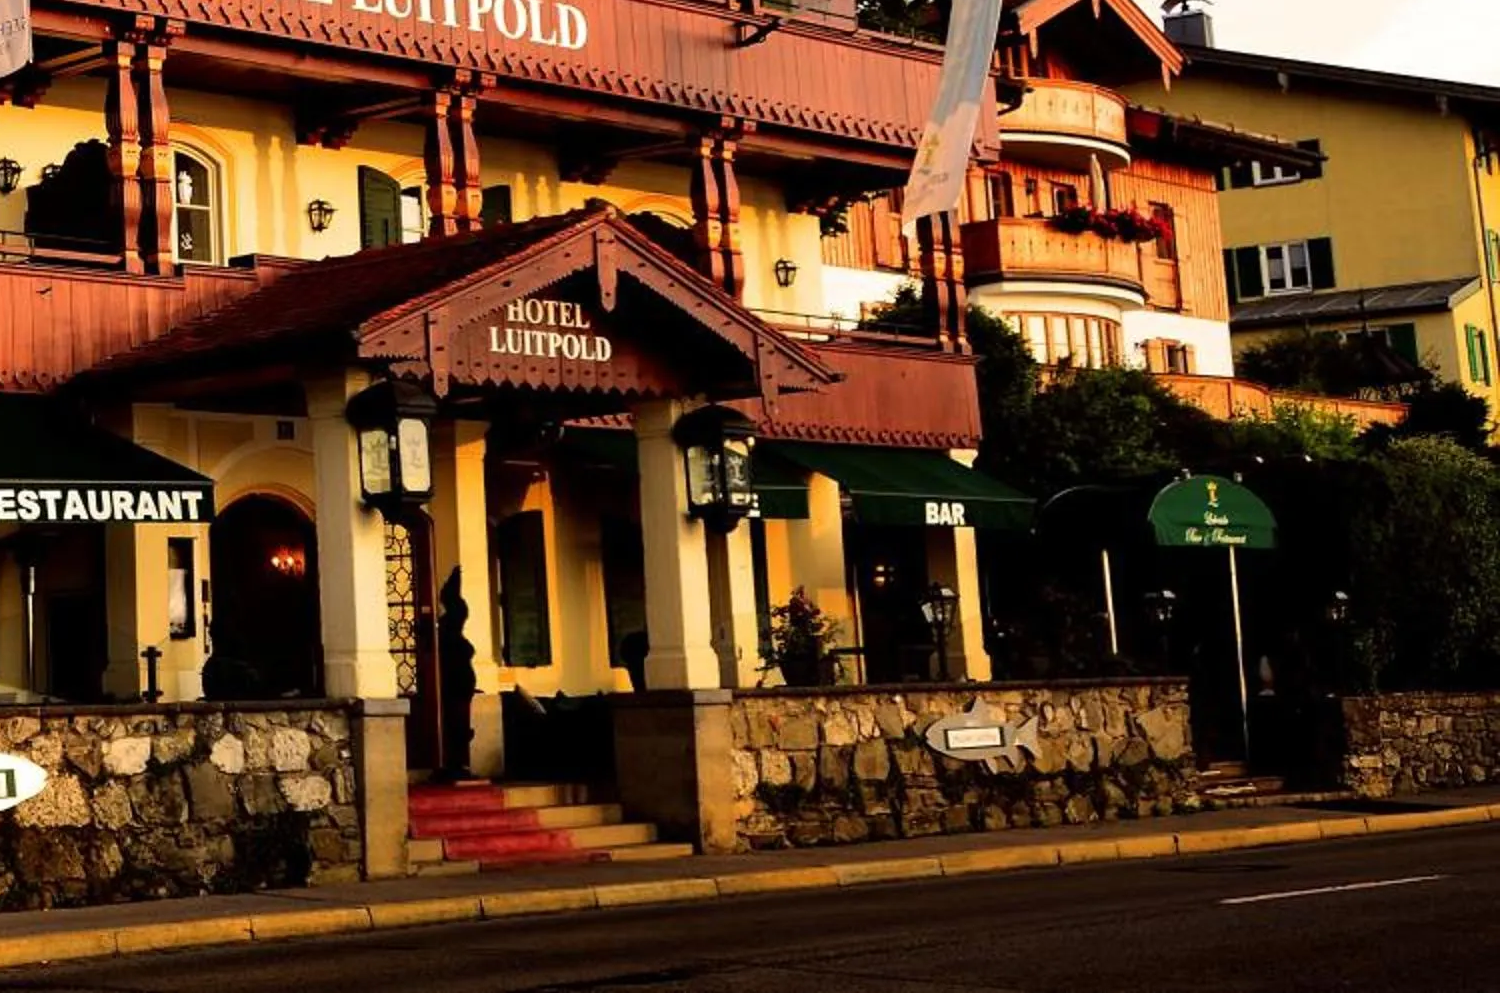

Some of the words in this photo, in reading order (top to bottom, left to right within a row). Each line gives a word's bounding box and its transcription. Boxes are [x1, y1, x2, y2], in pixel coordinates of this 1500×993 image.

[507, 298, 591, 329] HOTEL
[489, 326, 612, 362] LUITPOLD
[925, 502, 966, 526] BAR
